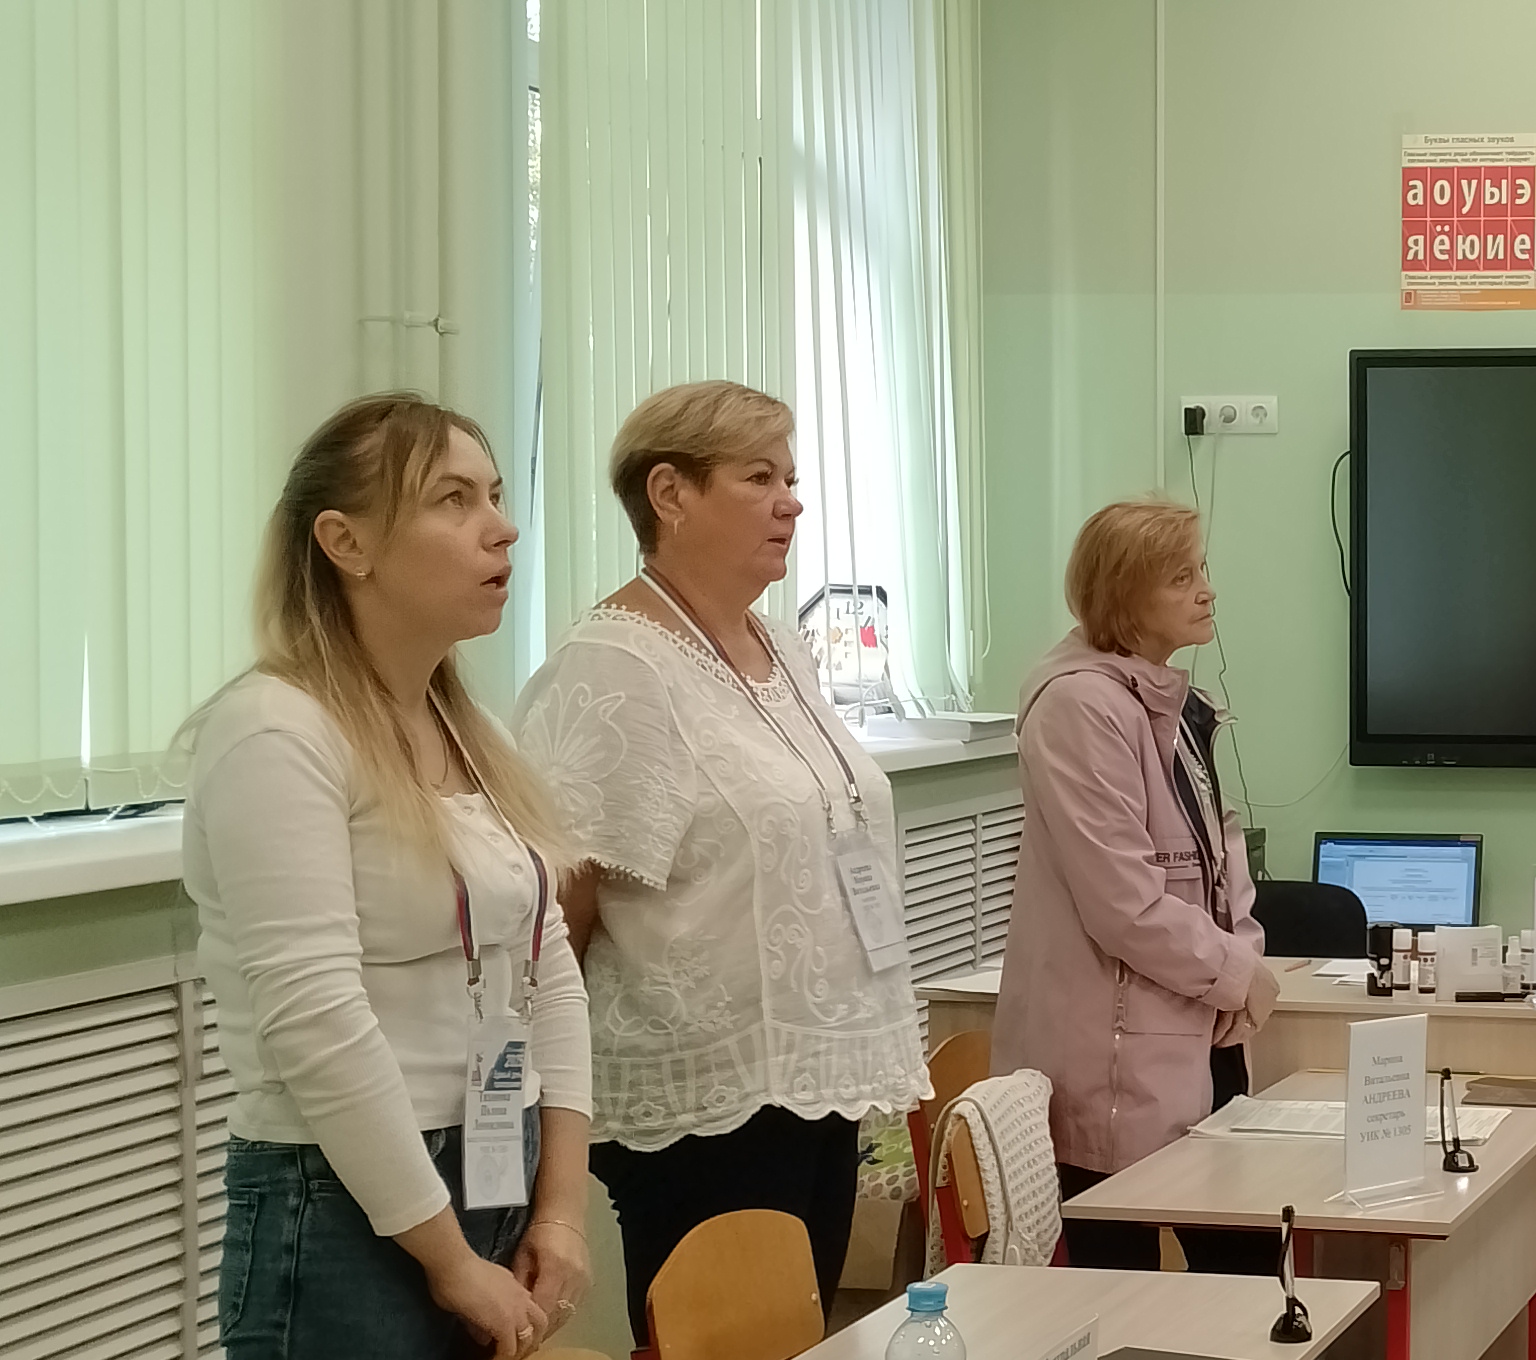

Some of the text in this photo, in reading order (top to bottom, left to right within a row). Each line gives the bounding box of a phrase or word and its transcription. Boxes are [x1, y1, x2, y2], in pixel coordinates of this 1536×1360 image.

[1406, 178, 1532, 215] а о у ы э
[1406, 223, 1532, 261] я ё ю и е
[1155, 852, 1171, 863] ER
[1362, 1088, 1411, 1105] АНДРЕЕВА
